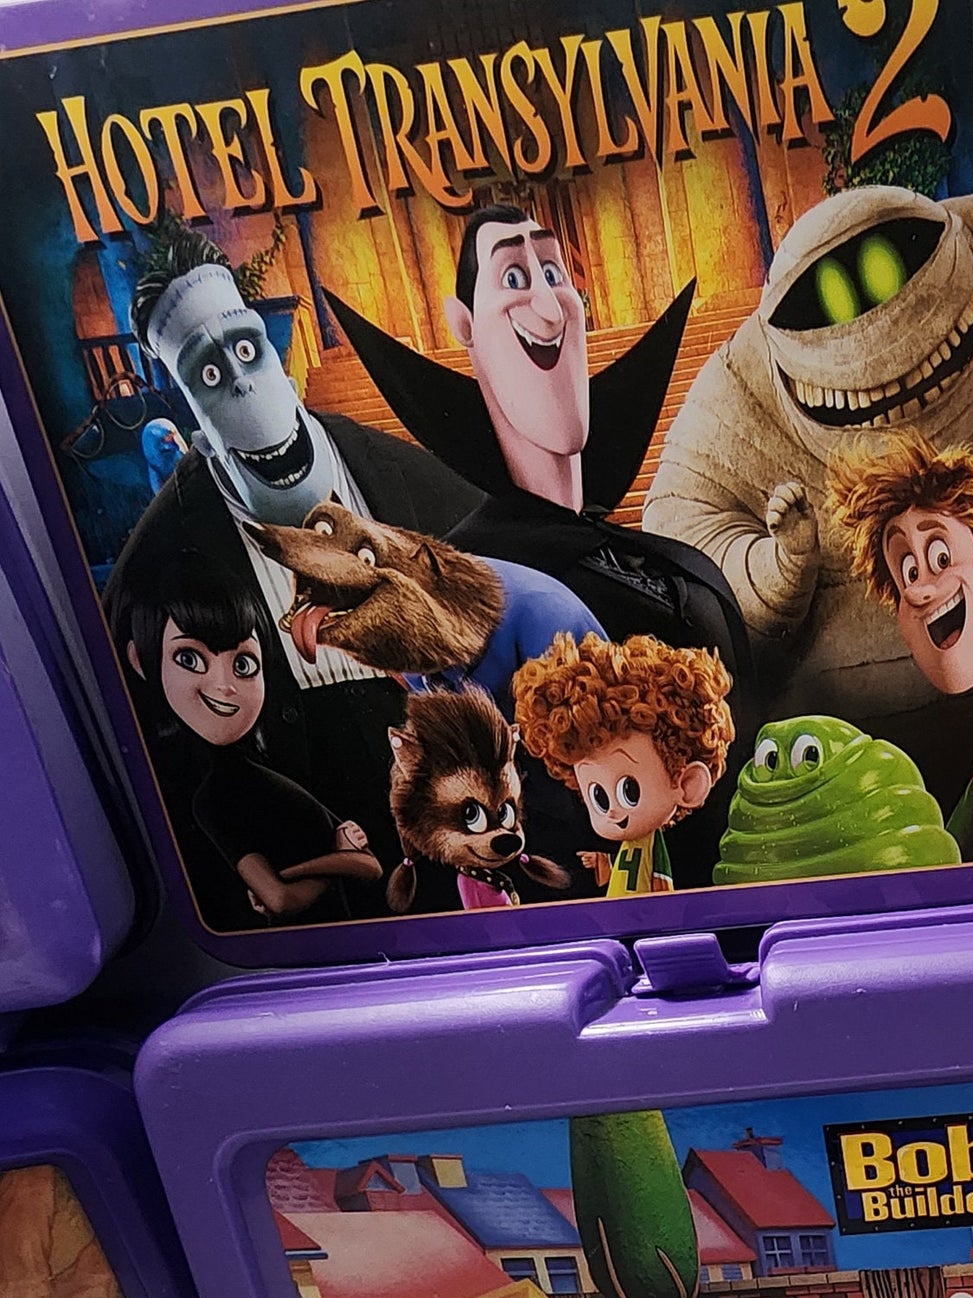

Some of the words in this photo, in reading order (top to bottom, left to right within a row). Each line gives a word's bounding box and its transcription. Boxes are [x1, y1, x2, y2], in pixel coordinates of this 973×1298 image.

[36, 87, 321, 245] HOTEL
[300, 3, 837, 222] TRANSYLVANIA
[836, 0, 953, 162] 2
[617, 847, 640, 892] 4
[888, 1186, 913, 1198] the
